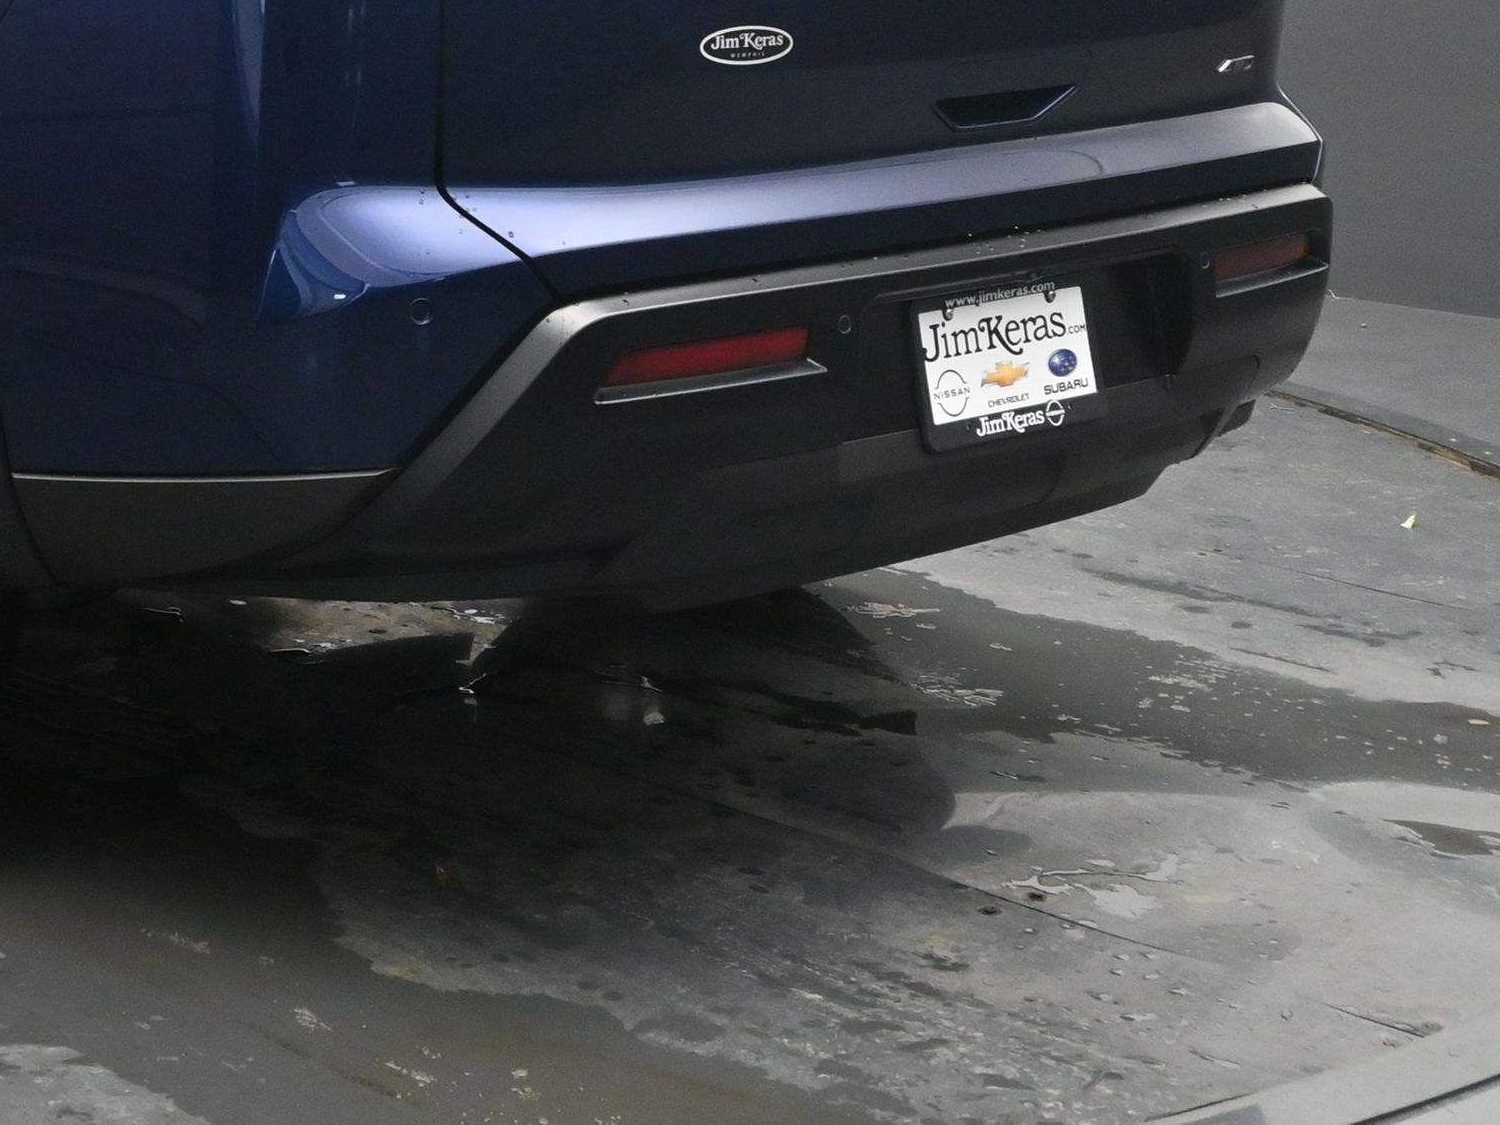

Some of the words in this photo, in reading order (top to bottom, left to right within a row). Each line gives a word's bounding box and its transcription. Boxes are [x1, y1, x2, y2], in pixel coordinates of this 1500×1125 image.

[945, 282, 1055, 307] www.jimkeras.com
[933, 386, 971, 400] NISSAN
[1044, 378, 1089, 395] SUBARU
[988, 393, 1030, 408] CHEVROLET
